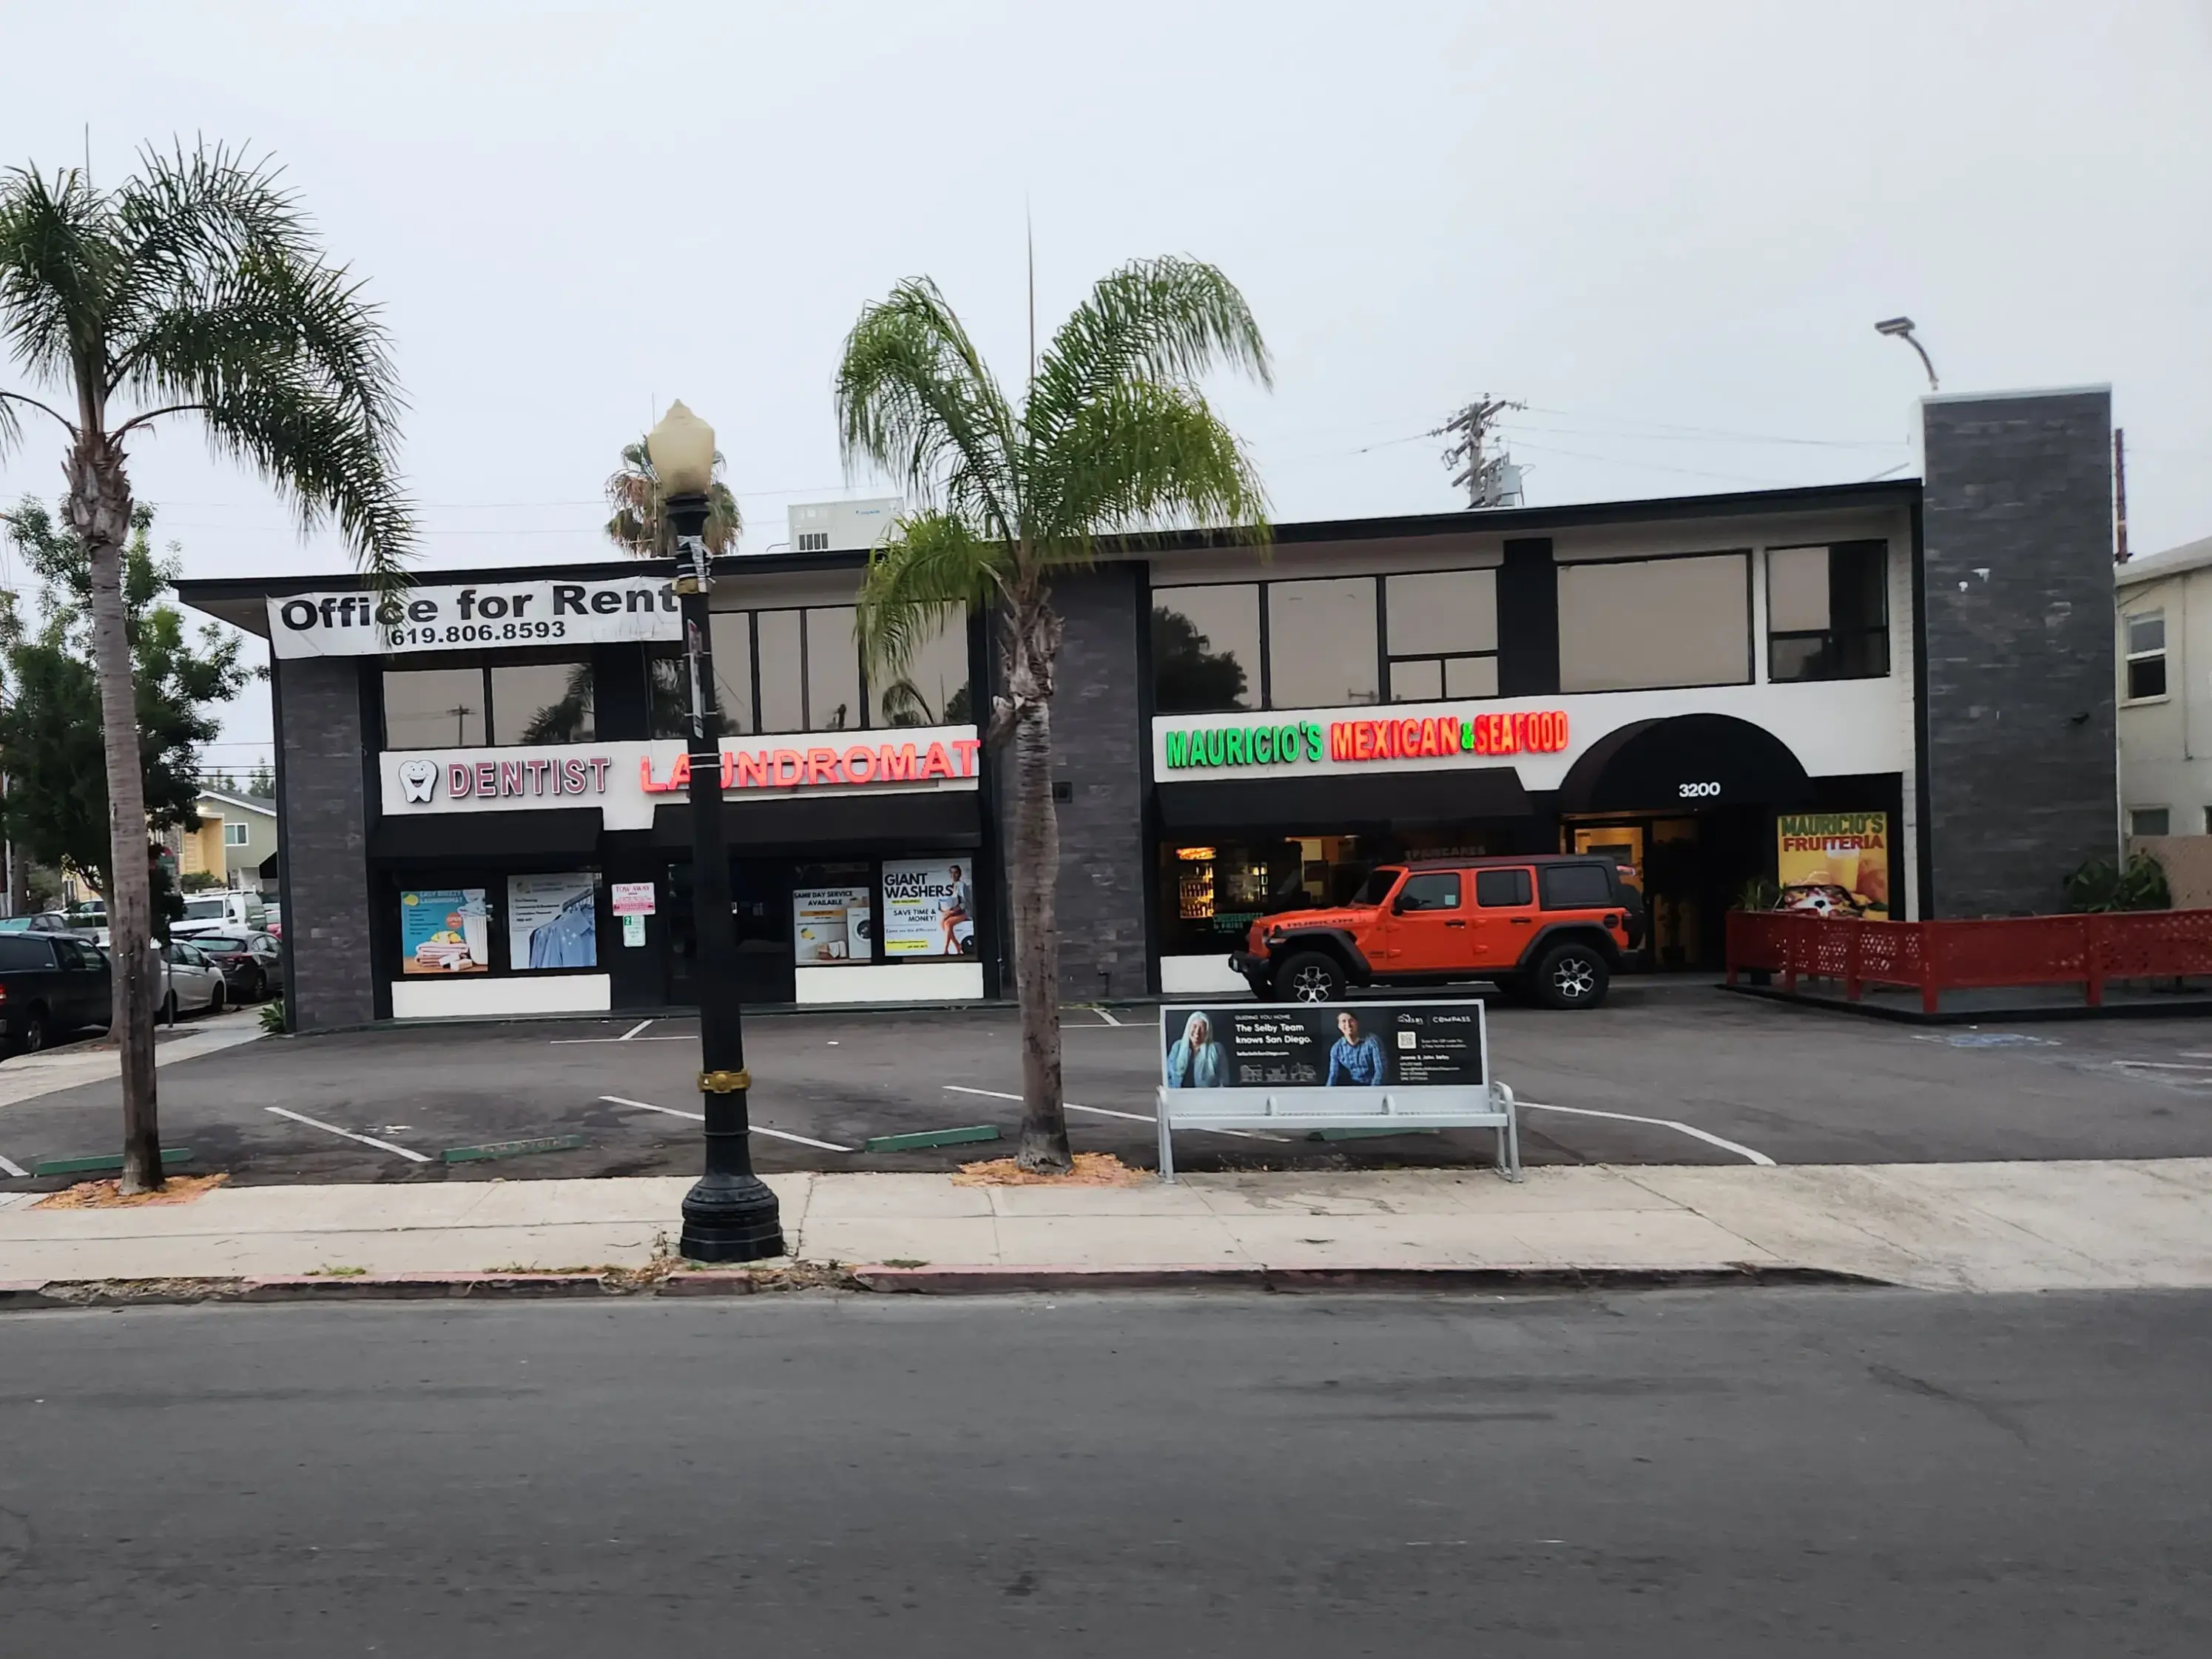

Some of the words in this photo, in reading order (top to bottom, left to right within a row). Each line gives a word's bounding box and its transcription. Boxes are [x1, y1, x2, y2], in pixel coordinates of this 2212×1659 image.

[281, 597, 438, 630] Office
[457, 590, 533, 621] for
[552, 582, 678, 616] Rent
[391, 621, 566, 646] 619.806.8593
[1167, 721, 1324, 768] MAURICIO'S
[1330, 717, 1460, 761] MEXICAN
[1461, 722, 1474, 750] &
[1474, 711, 1568, 755] SEAFOOD
[446, 757, 611, 798] DENTIST
[1679, 782, 1721, 798] 3200
[1781, 814, 1884, 837] MAURICIO'S
[884, 873, 928, 886] GIANT
[884, 884, 954, 898] WASHERS
[1235, 1023, 1252, 1032] The
[1254, 1023, 1278, 1033] Selby
[1280, 1023, 1304, 1032] Team
[1265, 1035, 1283, 1043] San
[1284, 1035, 1312, 1045] Diego.
